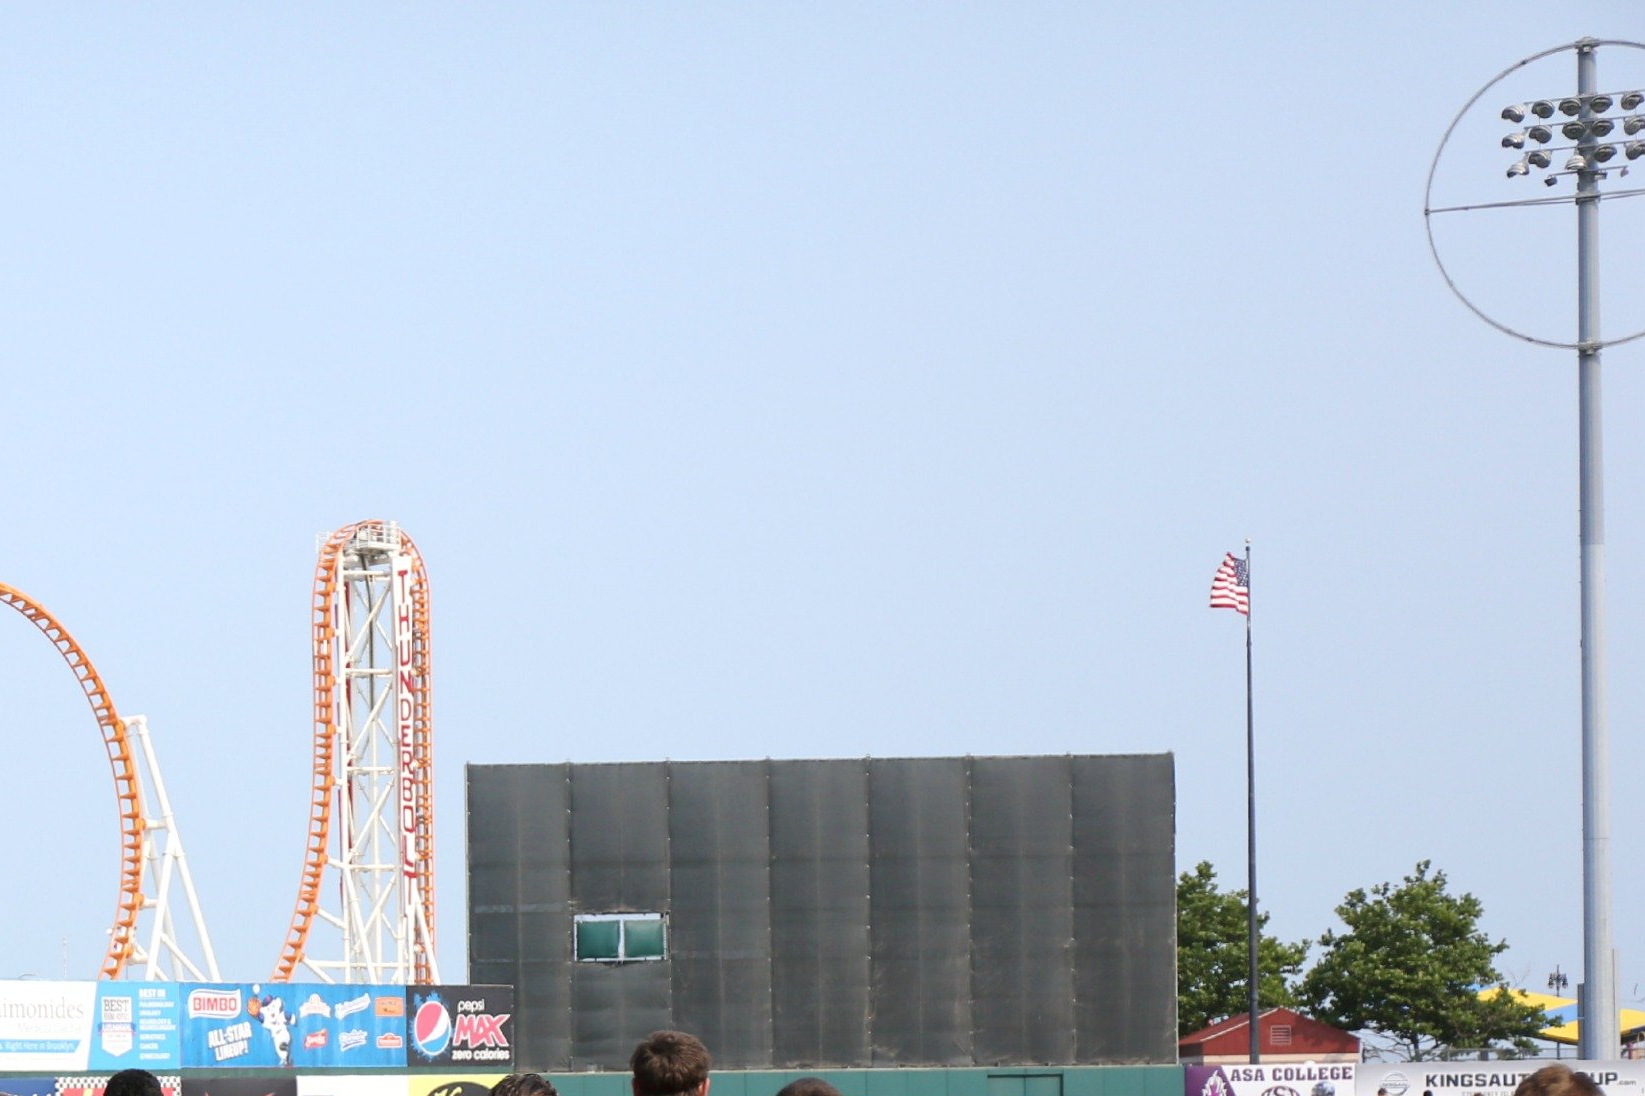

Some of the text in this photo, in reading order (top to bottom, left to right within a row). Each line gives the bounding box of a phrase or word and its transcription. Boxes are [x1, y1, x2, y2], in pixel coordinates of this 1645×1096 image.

[103, 998, 130, 1012] BEST
[192, 996, 238, 1012] BIMBO
[457, 999, 485, 1013] pepsi
[207, 1021, 253, 1048] ALL-STAR
[452, 1013, 511, 1049] MAX
[214, 1041, 249, 1061] LINEUP!
[452, 1047, 510, 1060] zero calories
[1230, 1065, 1353, 1082] ASA COLLEGE
